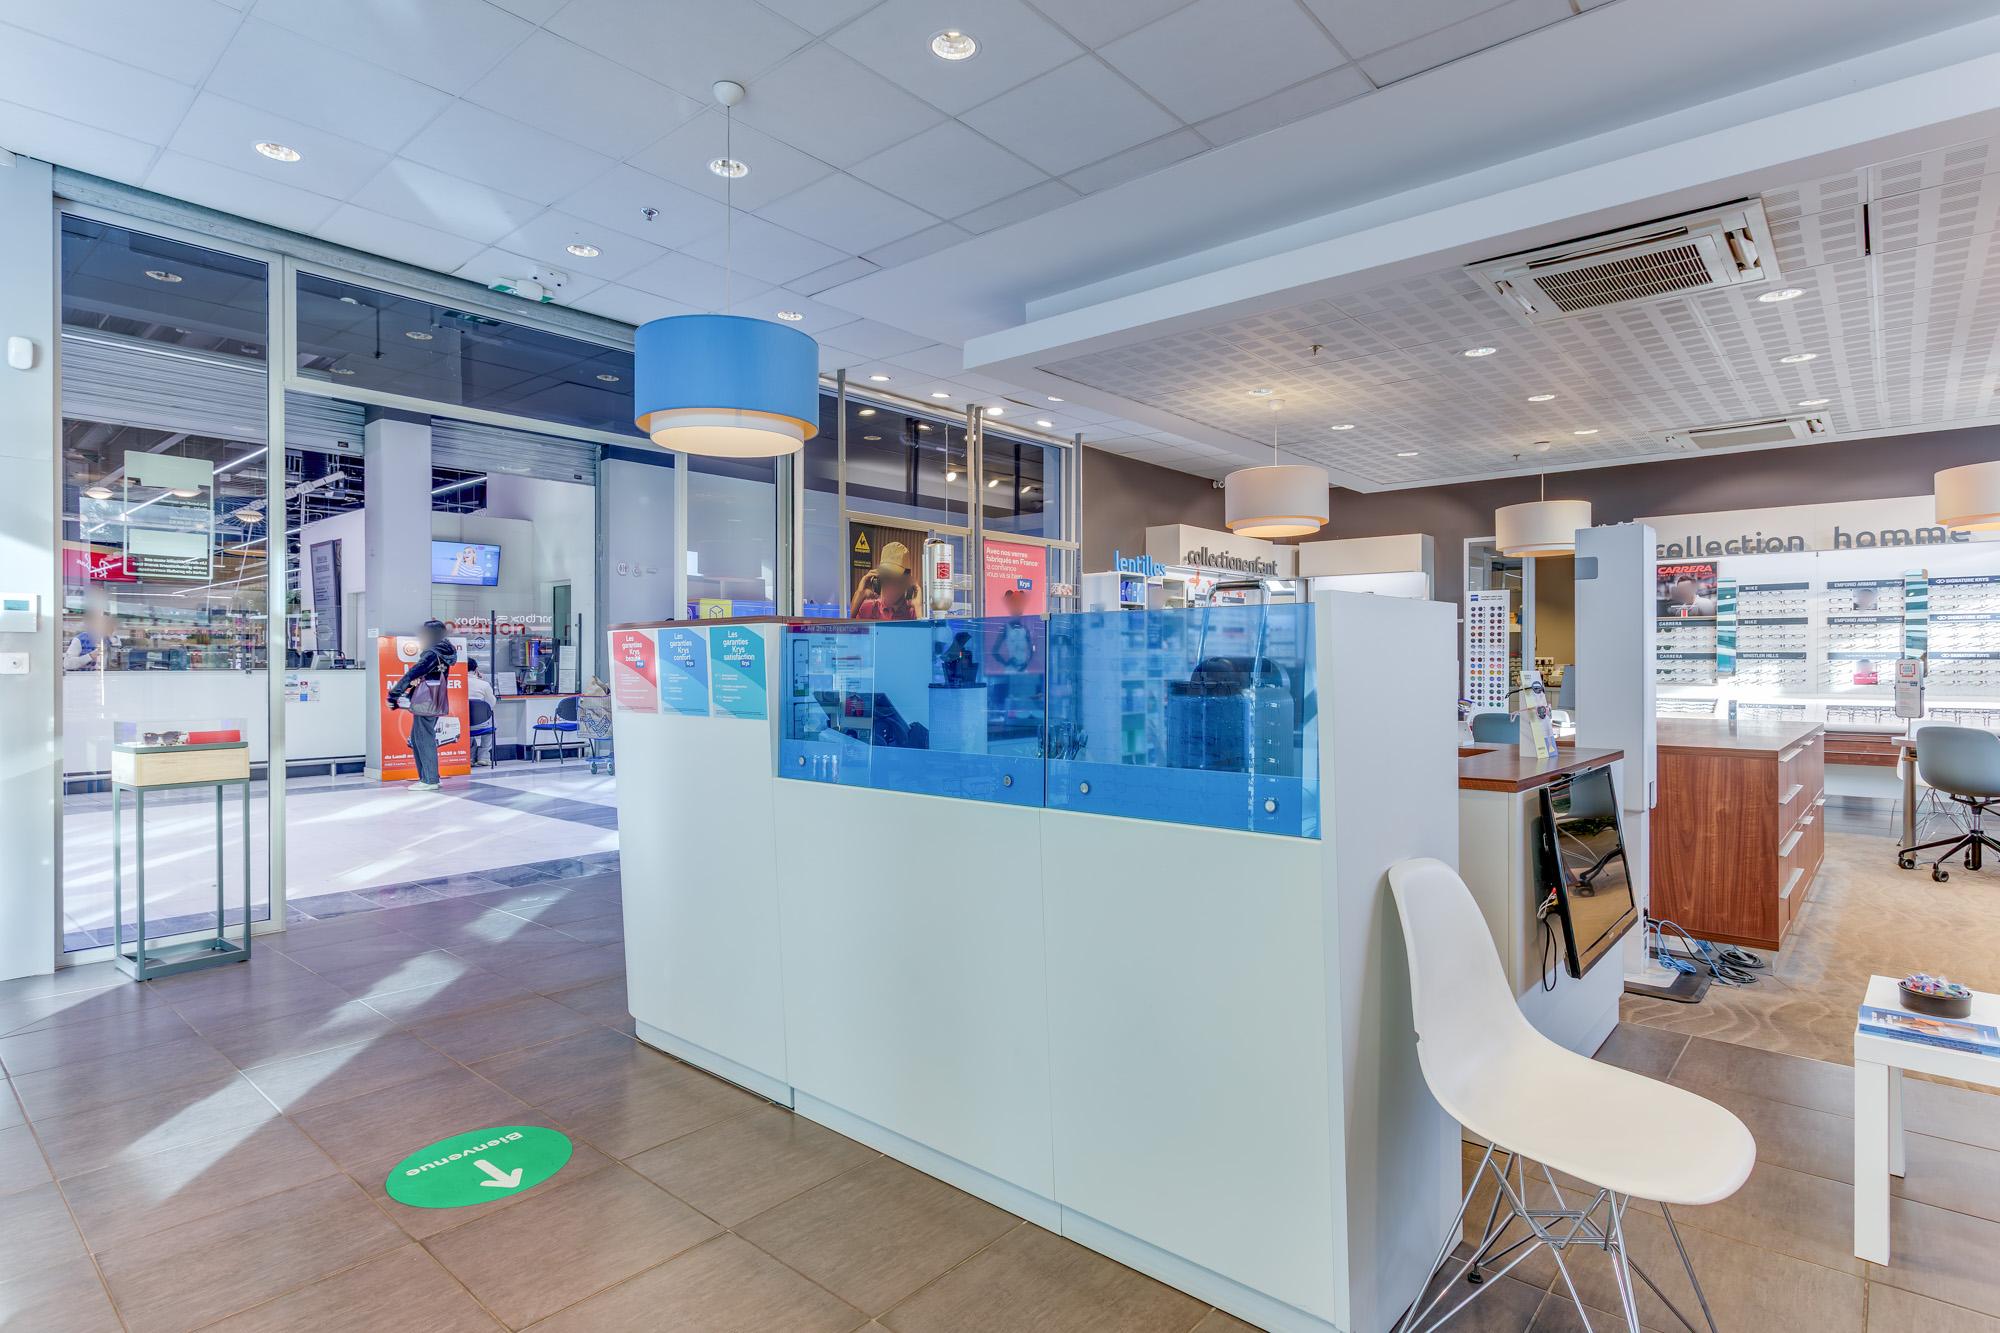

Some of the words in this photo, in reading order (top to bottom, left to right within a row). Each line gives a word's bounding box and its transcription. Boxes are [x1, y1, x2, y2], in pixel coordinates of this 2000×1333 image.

[1656, 531, 1805, 558] collection
[1833, 526, 1971, 550] homme
[986, 546, 1000, 555] Avec
[986, 555, 1012, 564] fabriqués
[1114, 549, 1166, 577] lentilles
[1657, 564, 1713, 574] CARRERA
[1019, 580, 1031, 588] Krys
[673, 632, 683, 640] Les
[727, 630, 738, 638] Les
[621, 642, 643, 651] garanties
[669, 640, 693, 649] garanties
[722, 639, 749, 648] garanties
[678, 646, 690, 654] Krys
[732, 645, 745, 654] Krys
[674, 653, 691, 661] confort
[723, 653, 756, 661] satisfaction
[405, 1131, 523, 1177] Bienvenue
